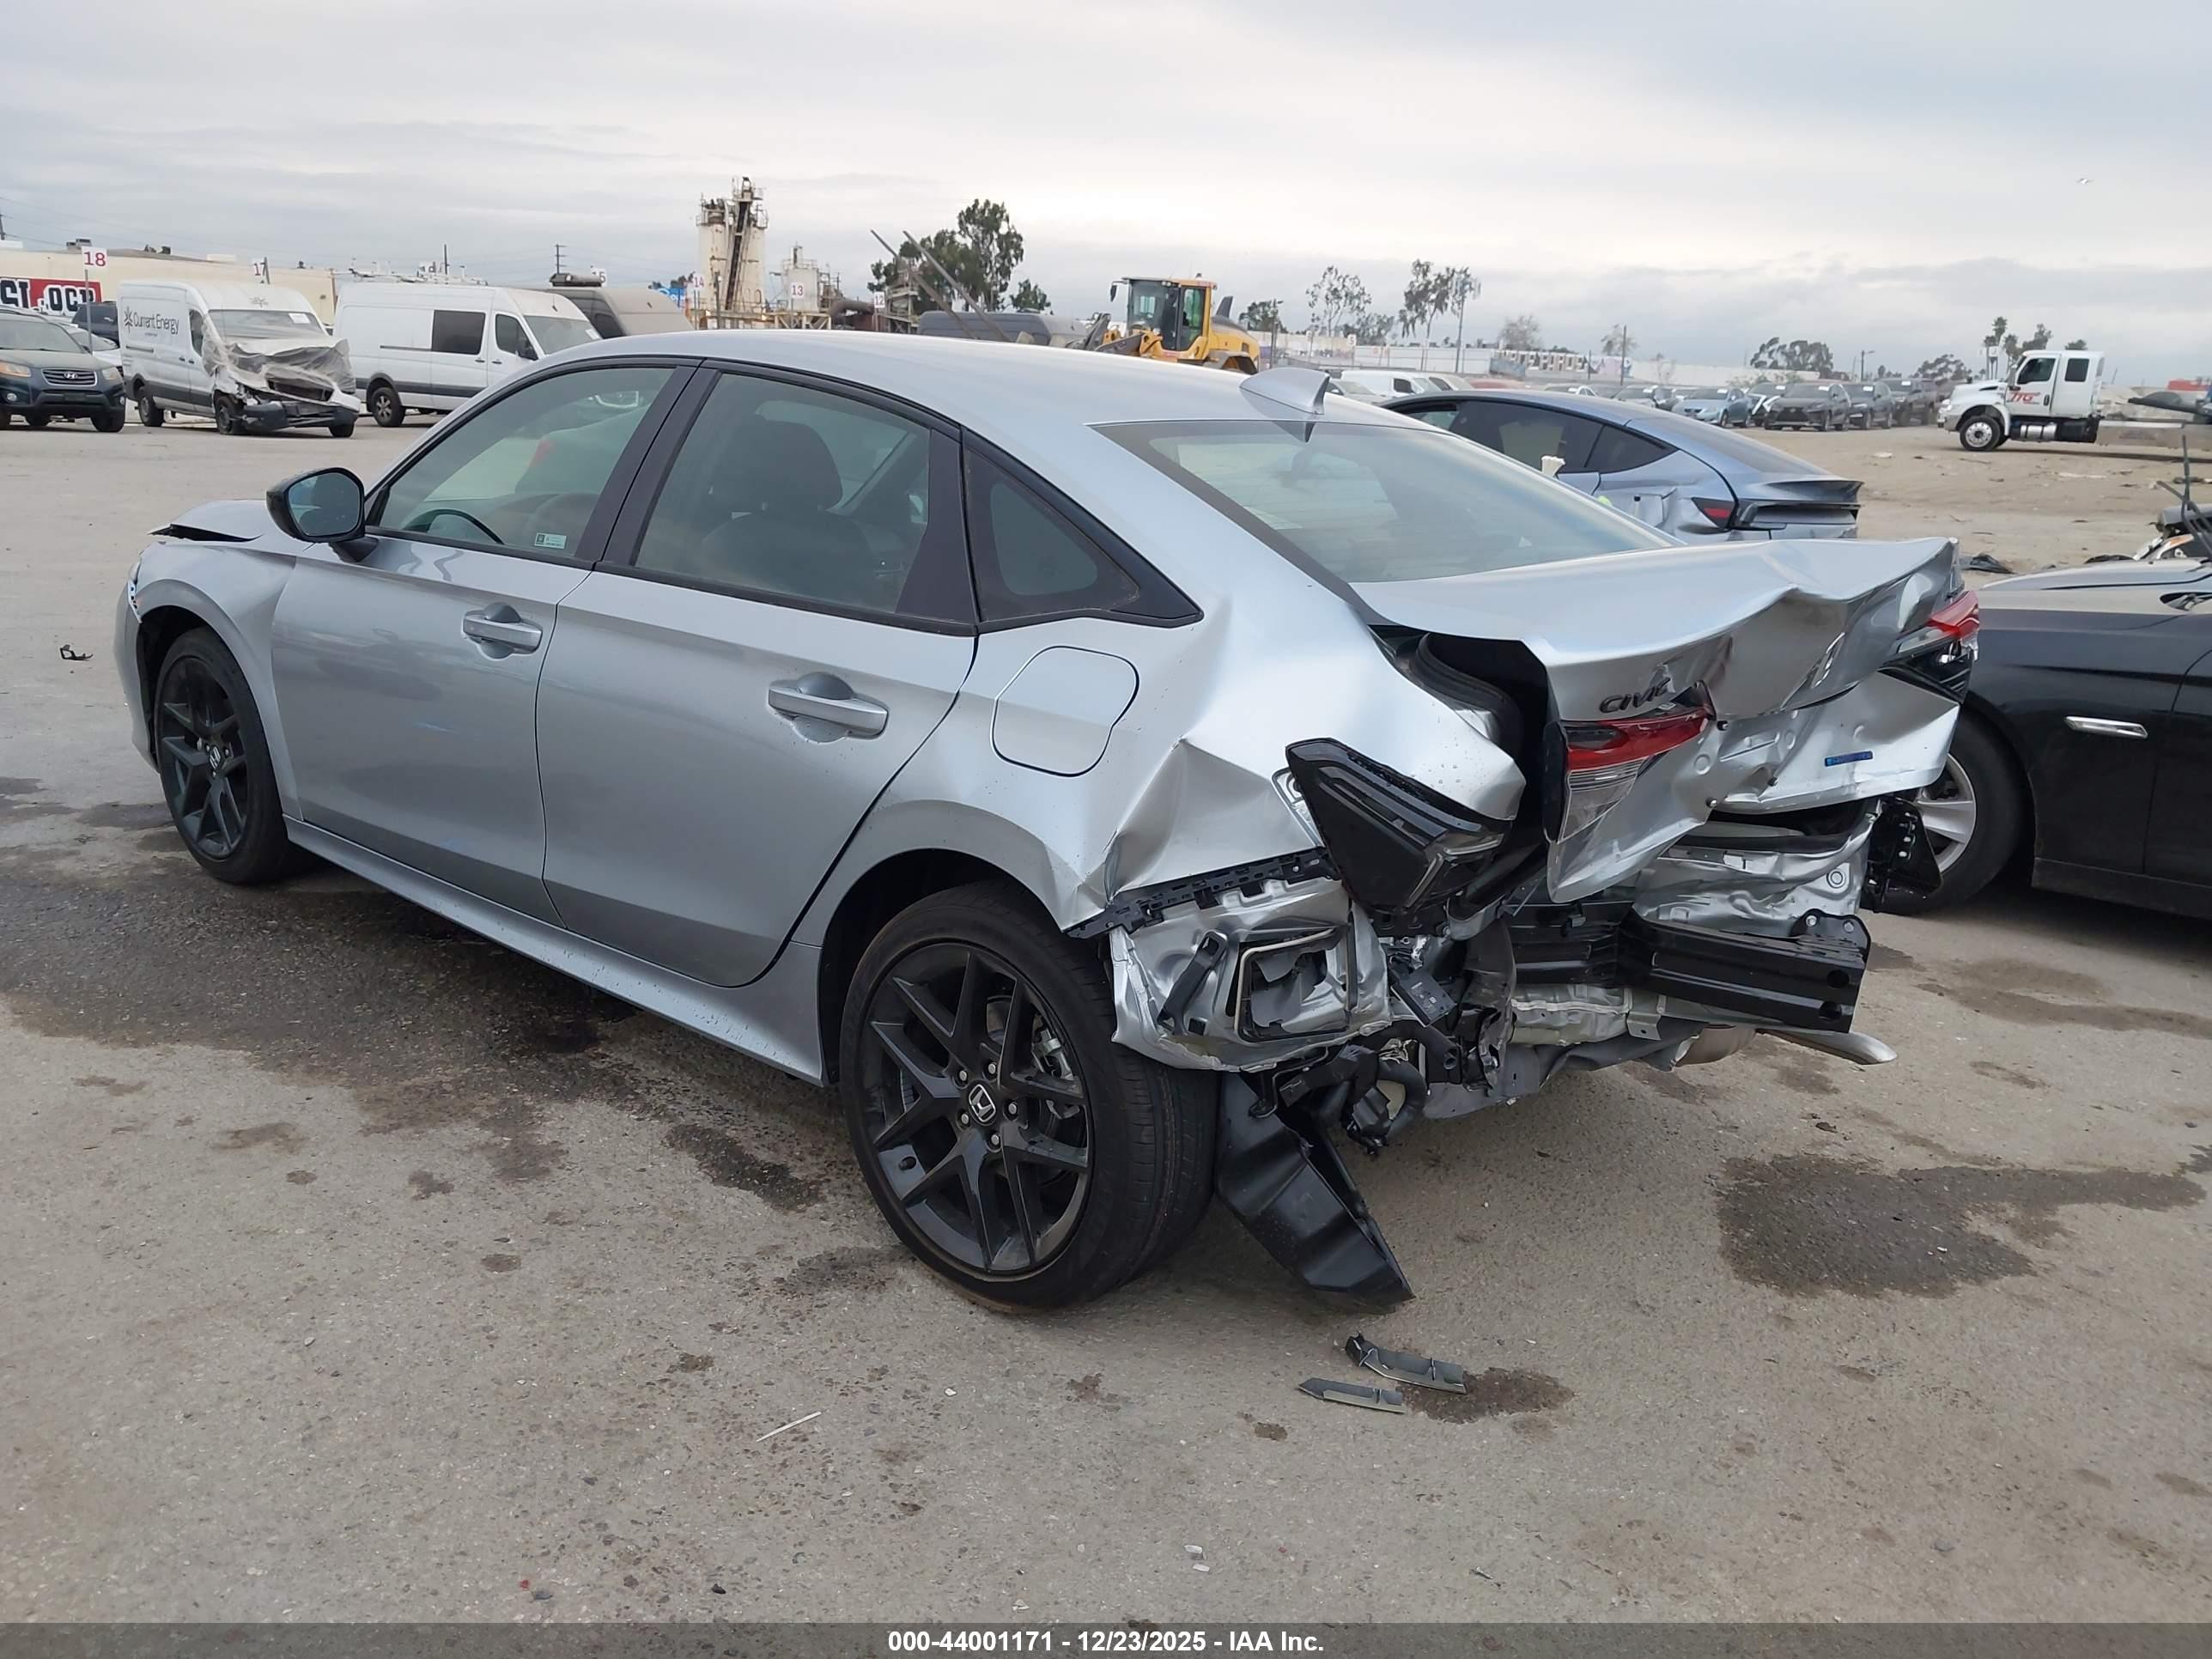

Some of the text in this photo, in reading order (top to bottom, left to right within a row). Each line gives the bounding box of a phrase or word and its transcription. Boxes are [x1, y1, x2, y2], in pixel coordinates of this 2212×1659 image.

[84, 251, 106, 267] 18
[792, 284, 804, 296] 13
[155, 313, 179, 335] Energy
[1599, 677, 1671, 714] CIVIC
